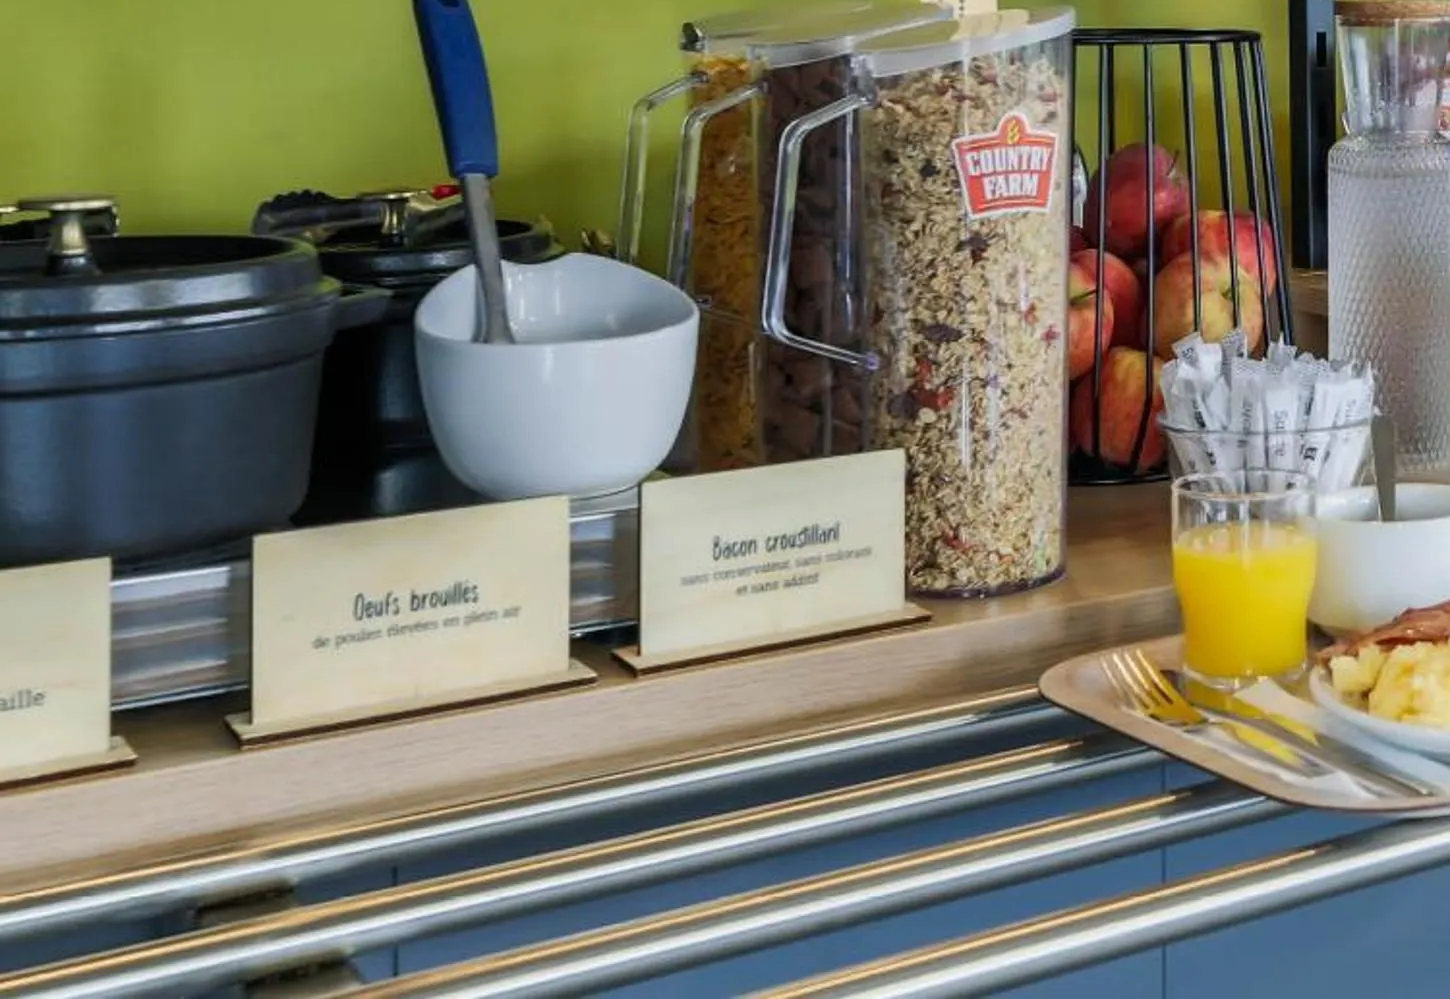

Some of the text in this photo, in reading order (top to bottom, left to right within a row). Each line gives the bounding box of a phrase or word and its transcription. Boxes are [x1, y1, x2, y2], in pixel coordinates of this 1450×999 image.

[966, 145, 1053, 176] COUNTRY
[983, 173, 1040, 201] FARM
[712, 521, 841, 561] Bacon croustillant
[353, 579, 479, 621] Oeufs brouillés
[312, 634, 331, 650] de
